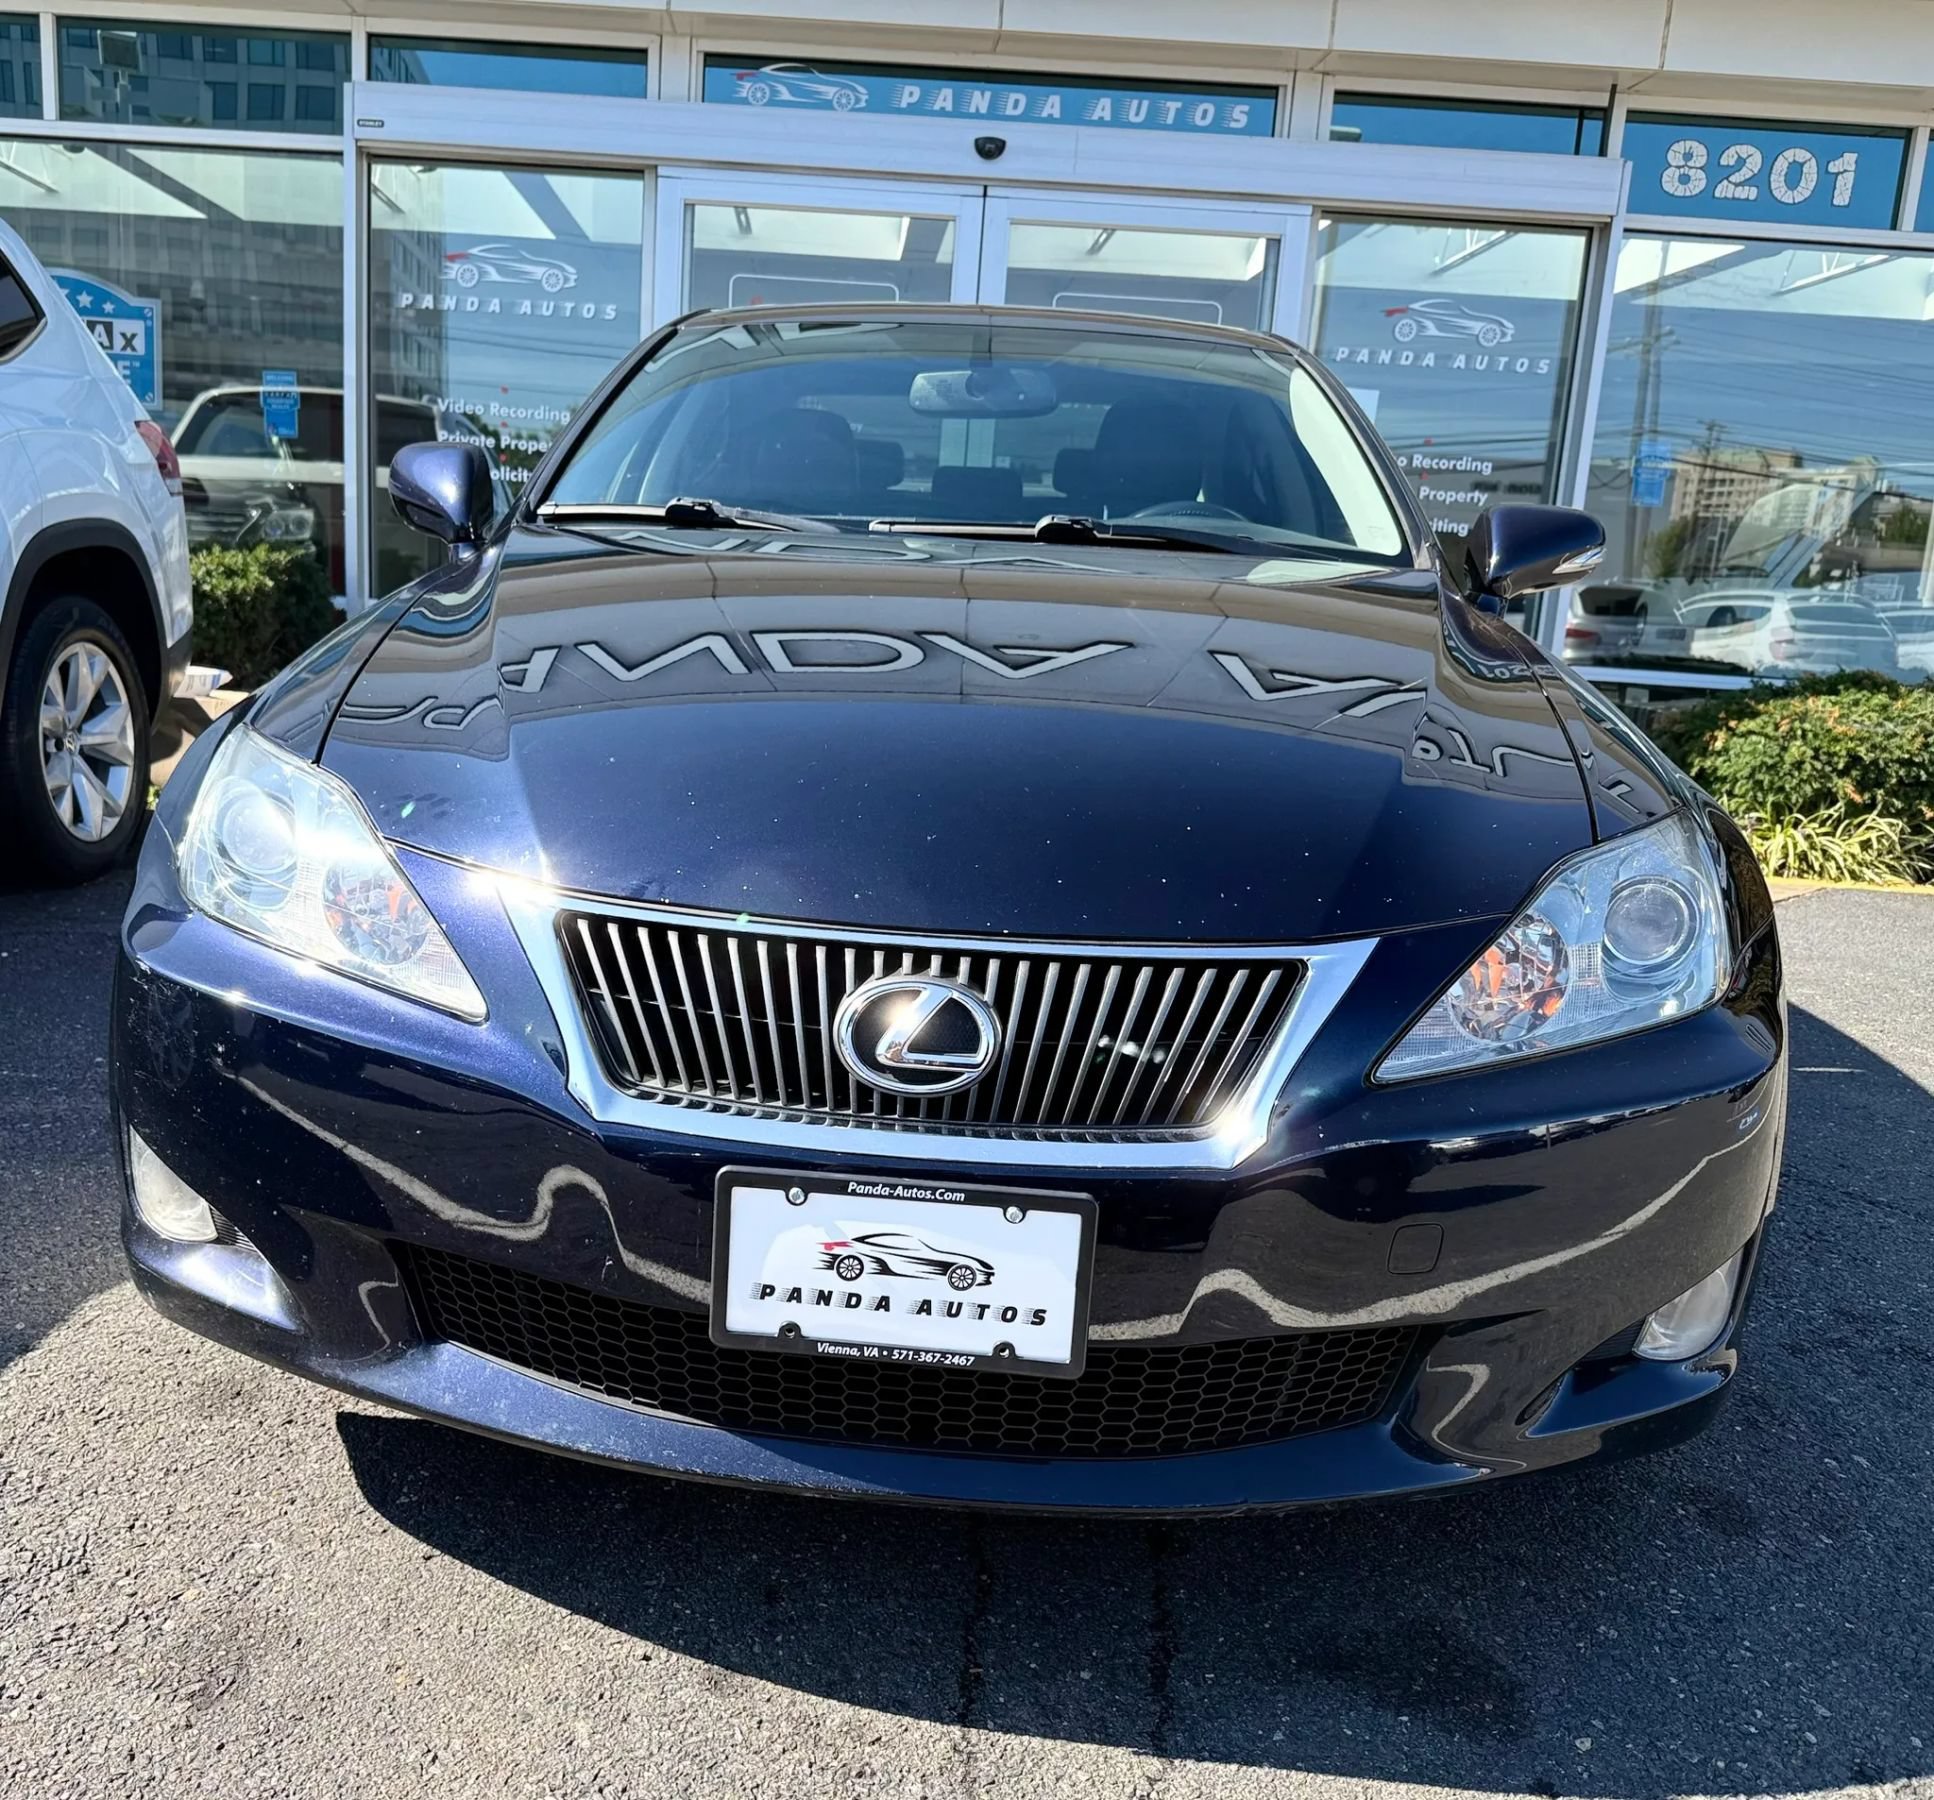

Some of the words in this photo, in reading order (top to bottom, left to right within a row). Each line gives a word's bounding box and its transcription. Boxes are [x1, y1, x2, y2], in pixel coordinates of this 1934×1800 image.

[890, 83, 1062, 119] PANDA
[1082, 97, 1250, 129] AUTOS
[1660, 138, 1859, 208] 8201
[400, 293, 502, 313] PANDA
[518, 299, 617, 320] AUTOS
[1335, 347, 1435, 367] PANDA
[1452, 354, 1551, 374] AUTOS
[437, 398, 485, 415] Video
[490, 402, 571, 425] Recording
[1412, 453, 1493, 475] Recording
[1419, 486, 1489, 507] Property
[847, 1181, 966, 1203] Panda-Autos.Com
[752, 1282, 891, 1312] PANDA
[906, 1299, 1048, 1326] AUTOS
[816, 1342, 862, 1358] Vienna,
[862, 1345, 880, 1359] VA
[891, 1348, 976, 1367] 571-367-2467
